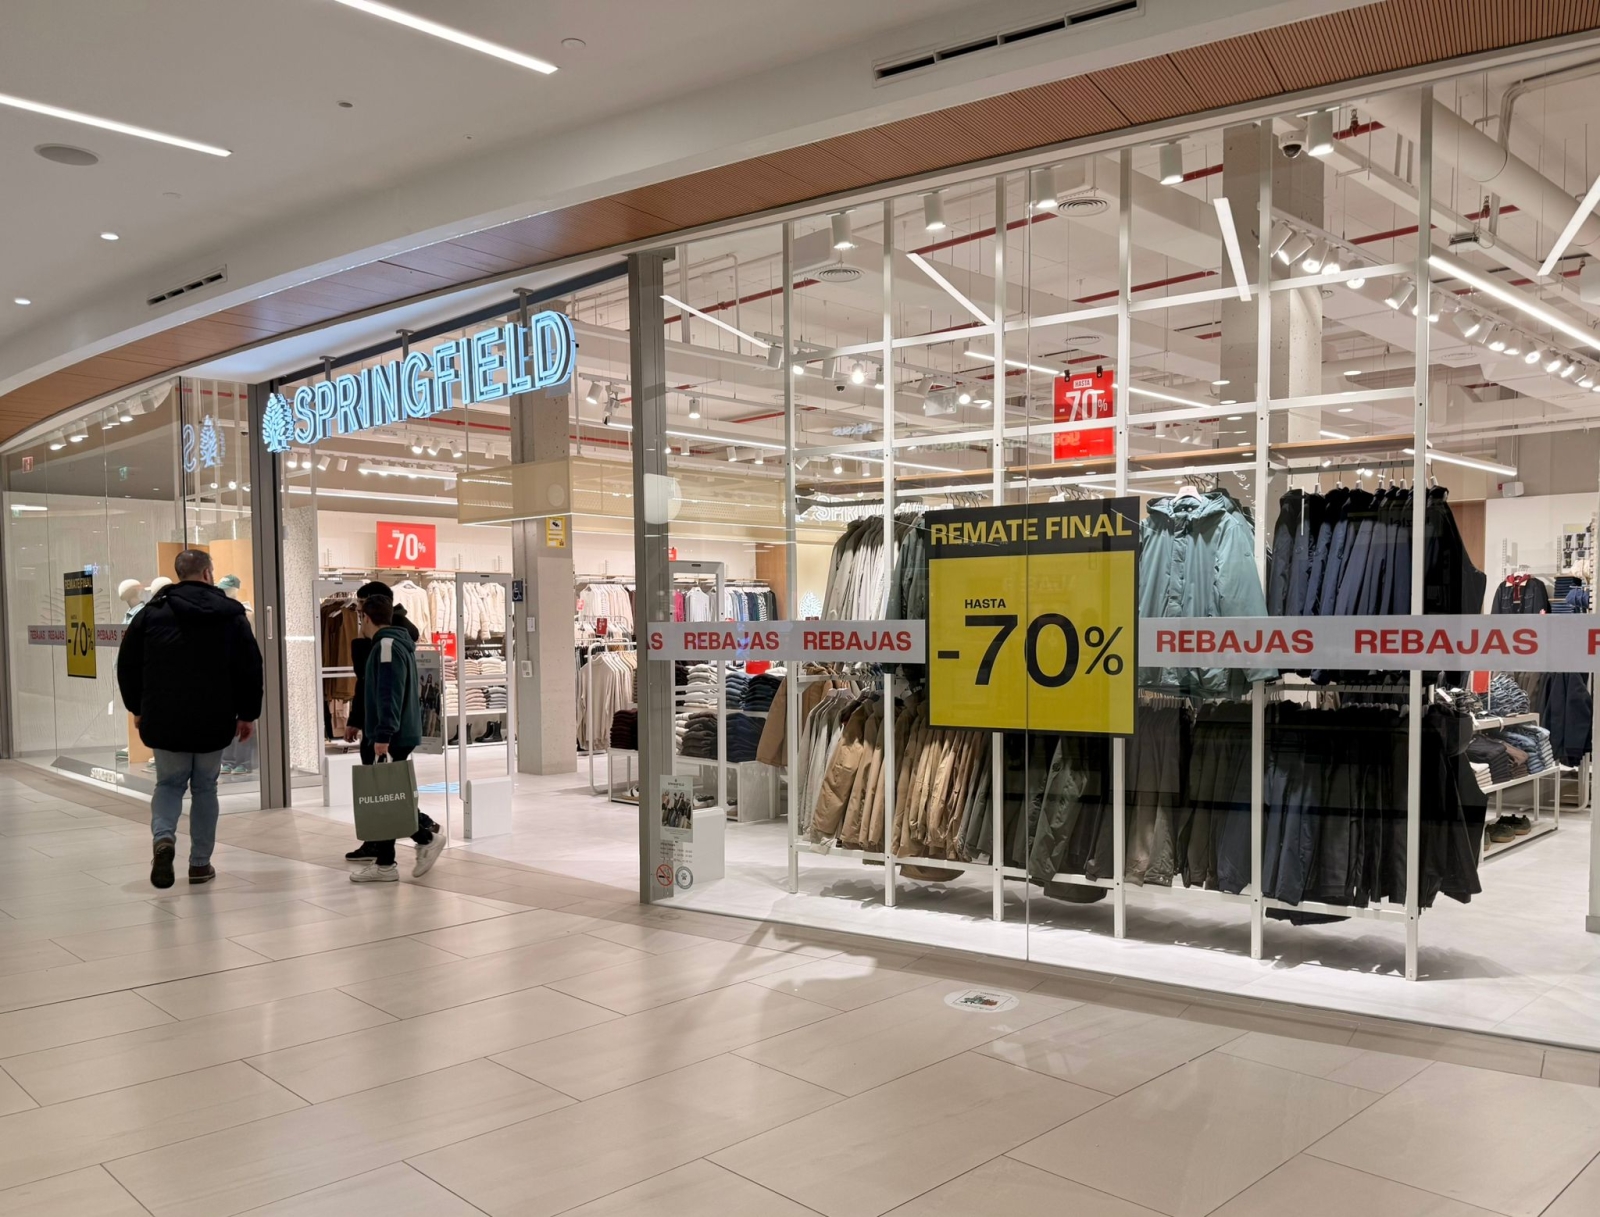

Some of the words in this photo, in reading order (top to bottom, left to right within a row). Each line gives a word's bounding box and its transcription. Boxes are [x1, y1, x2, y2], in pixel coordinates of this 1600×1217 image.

[294, 310, 576, 444] SPRINGFIELD
[1074, 379, 1091, 388] HASTA
[931, 518, 1039, 546] REMATE
[1046, 513, 1133, 539] FINAL
[387, 533, 426, 561] -70%
[965, 599, 1006, 609] HASTA
[684, 631, 780, 650] REBAJAS
[803, 631, 912, 651] REBAJAS
[938, 613, 1124, 688] -70%
[1156, 629, 1314, 654] REBAJAS
[1354, 628, 1539, 655] REBAJAS
[358, 792, 406, 805] PULL&BEAR
